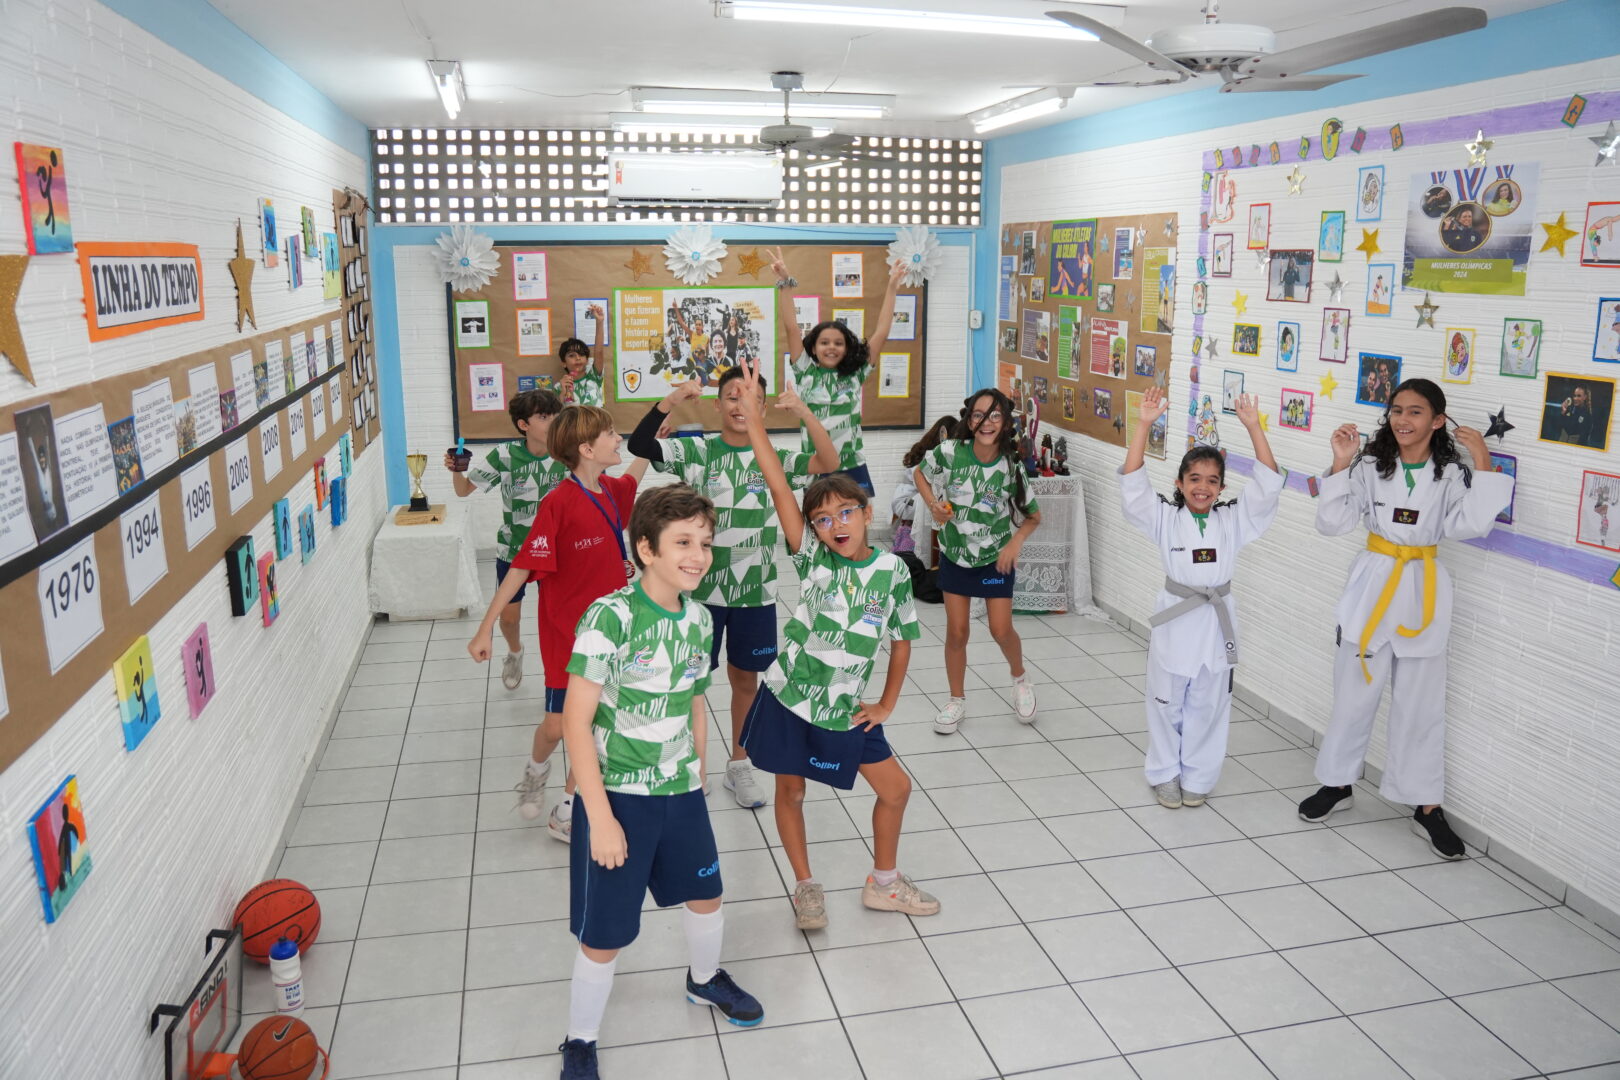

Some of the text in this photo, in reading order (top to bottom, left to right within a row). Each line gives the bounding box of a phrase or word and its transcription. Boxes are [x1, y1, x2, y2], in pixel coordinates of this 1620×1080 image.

[92, 263, 198, 315] LINHA DO TEMPO
[624, 294, 653, 304] Mulheres
[625, 305, 661, 316] que fizeram
[625, 328, 649, 337] história
[631, 318, 649, 326] fazem
[625, 340, 649, 349] esporte
[291, 408, 304, 435] 2016
[263, 424, 279, 455] 2008
[229, 455, 249, 491] 2003
[186, 481, 212, 522] 1996
[126, 507, 160, 559] 1994
[46, 555, 95, 619] 1976
[752, 645, 777, 656] Colibri
[809, 756, 841, 771] Colibri
